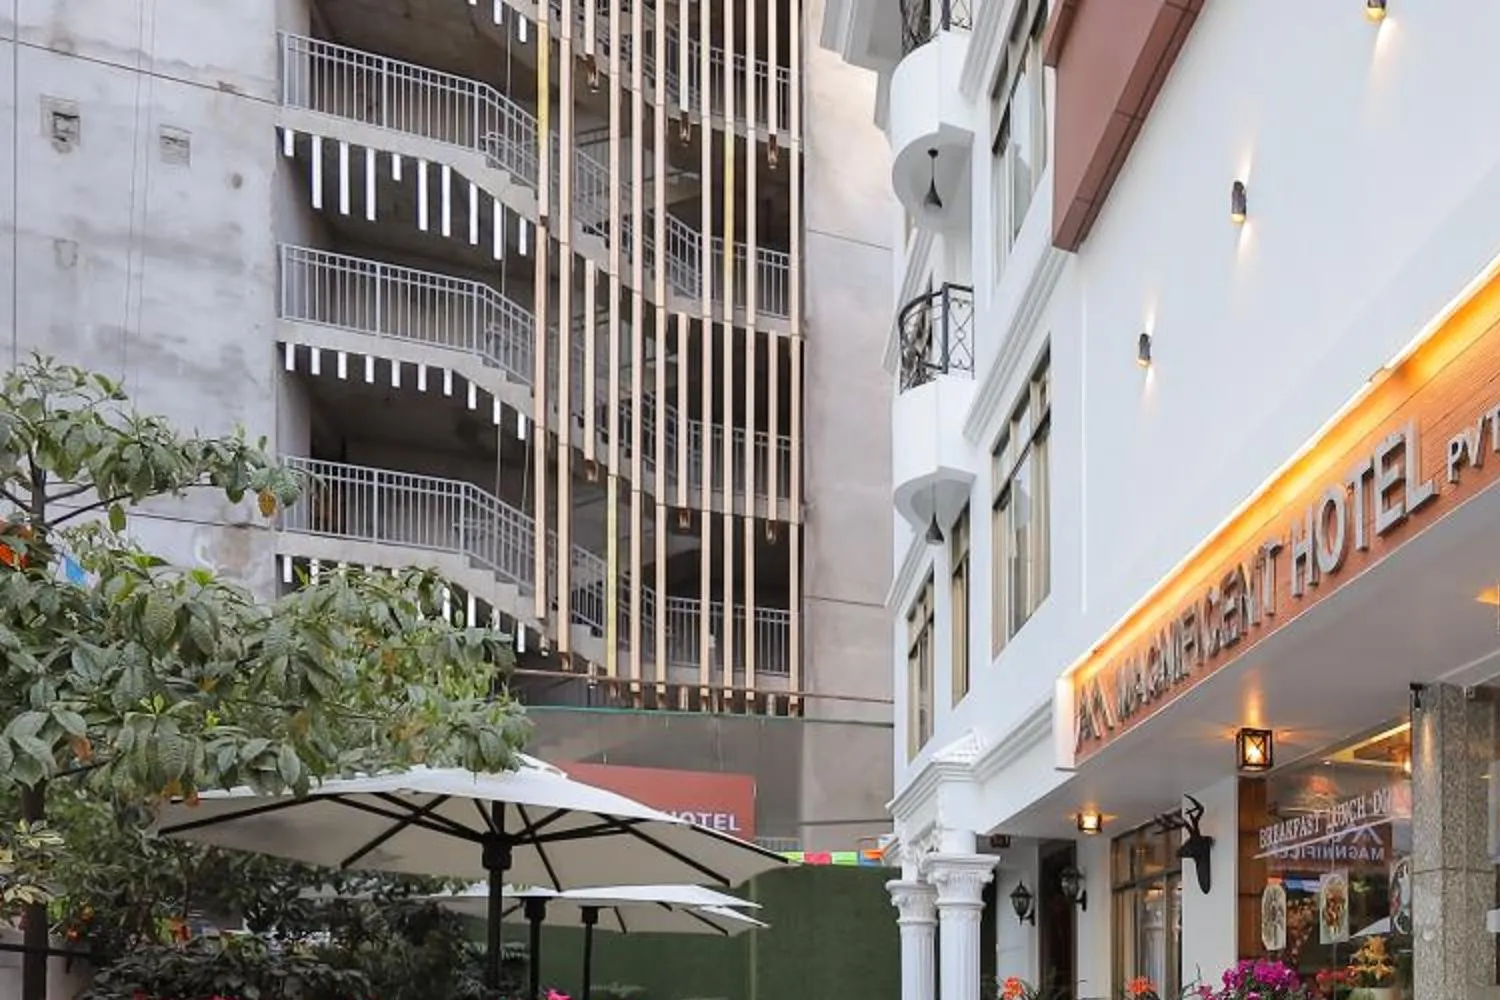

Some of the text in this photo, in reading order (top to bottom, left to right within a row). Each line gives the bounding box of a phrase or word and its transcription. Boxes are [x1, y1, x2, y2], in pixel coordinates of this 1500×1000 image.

[1291, 414, 1439, 598] HOTEL
[670, 811, 742, 832] OTEL
[1259, 811, 1320, 848] BREAKFAST
